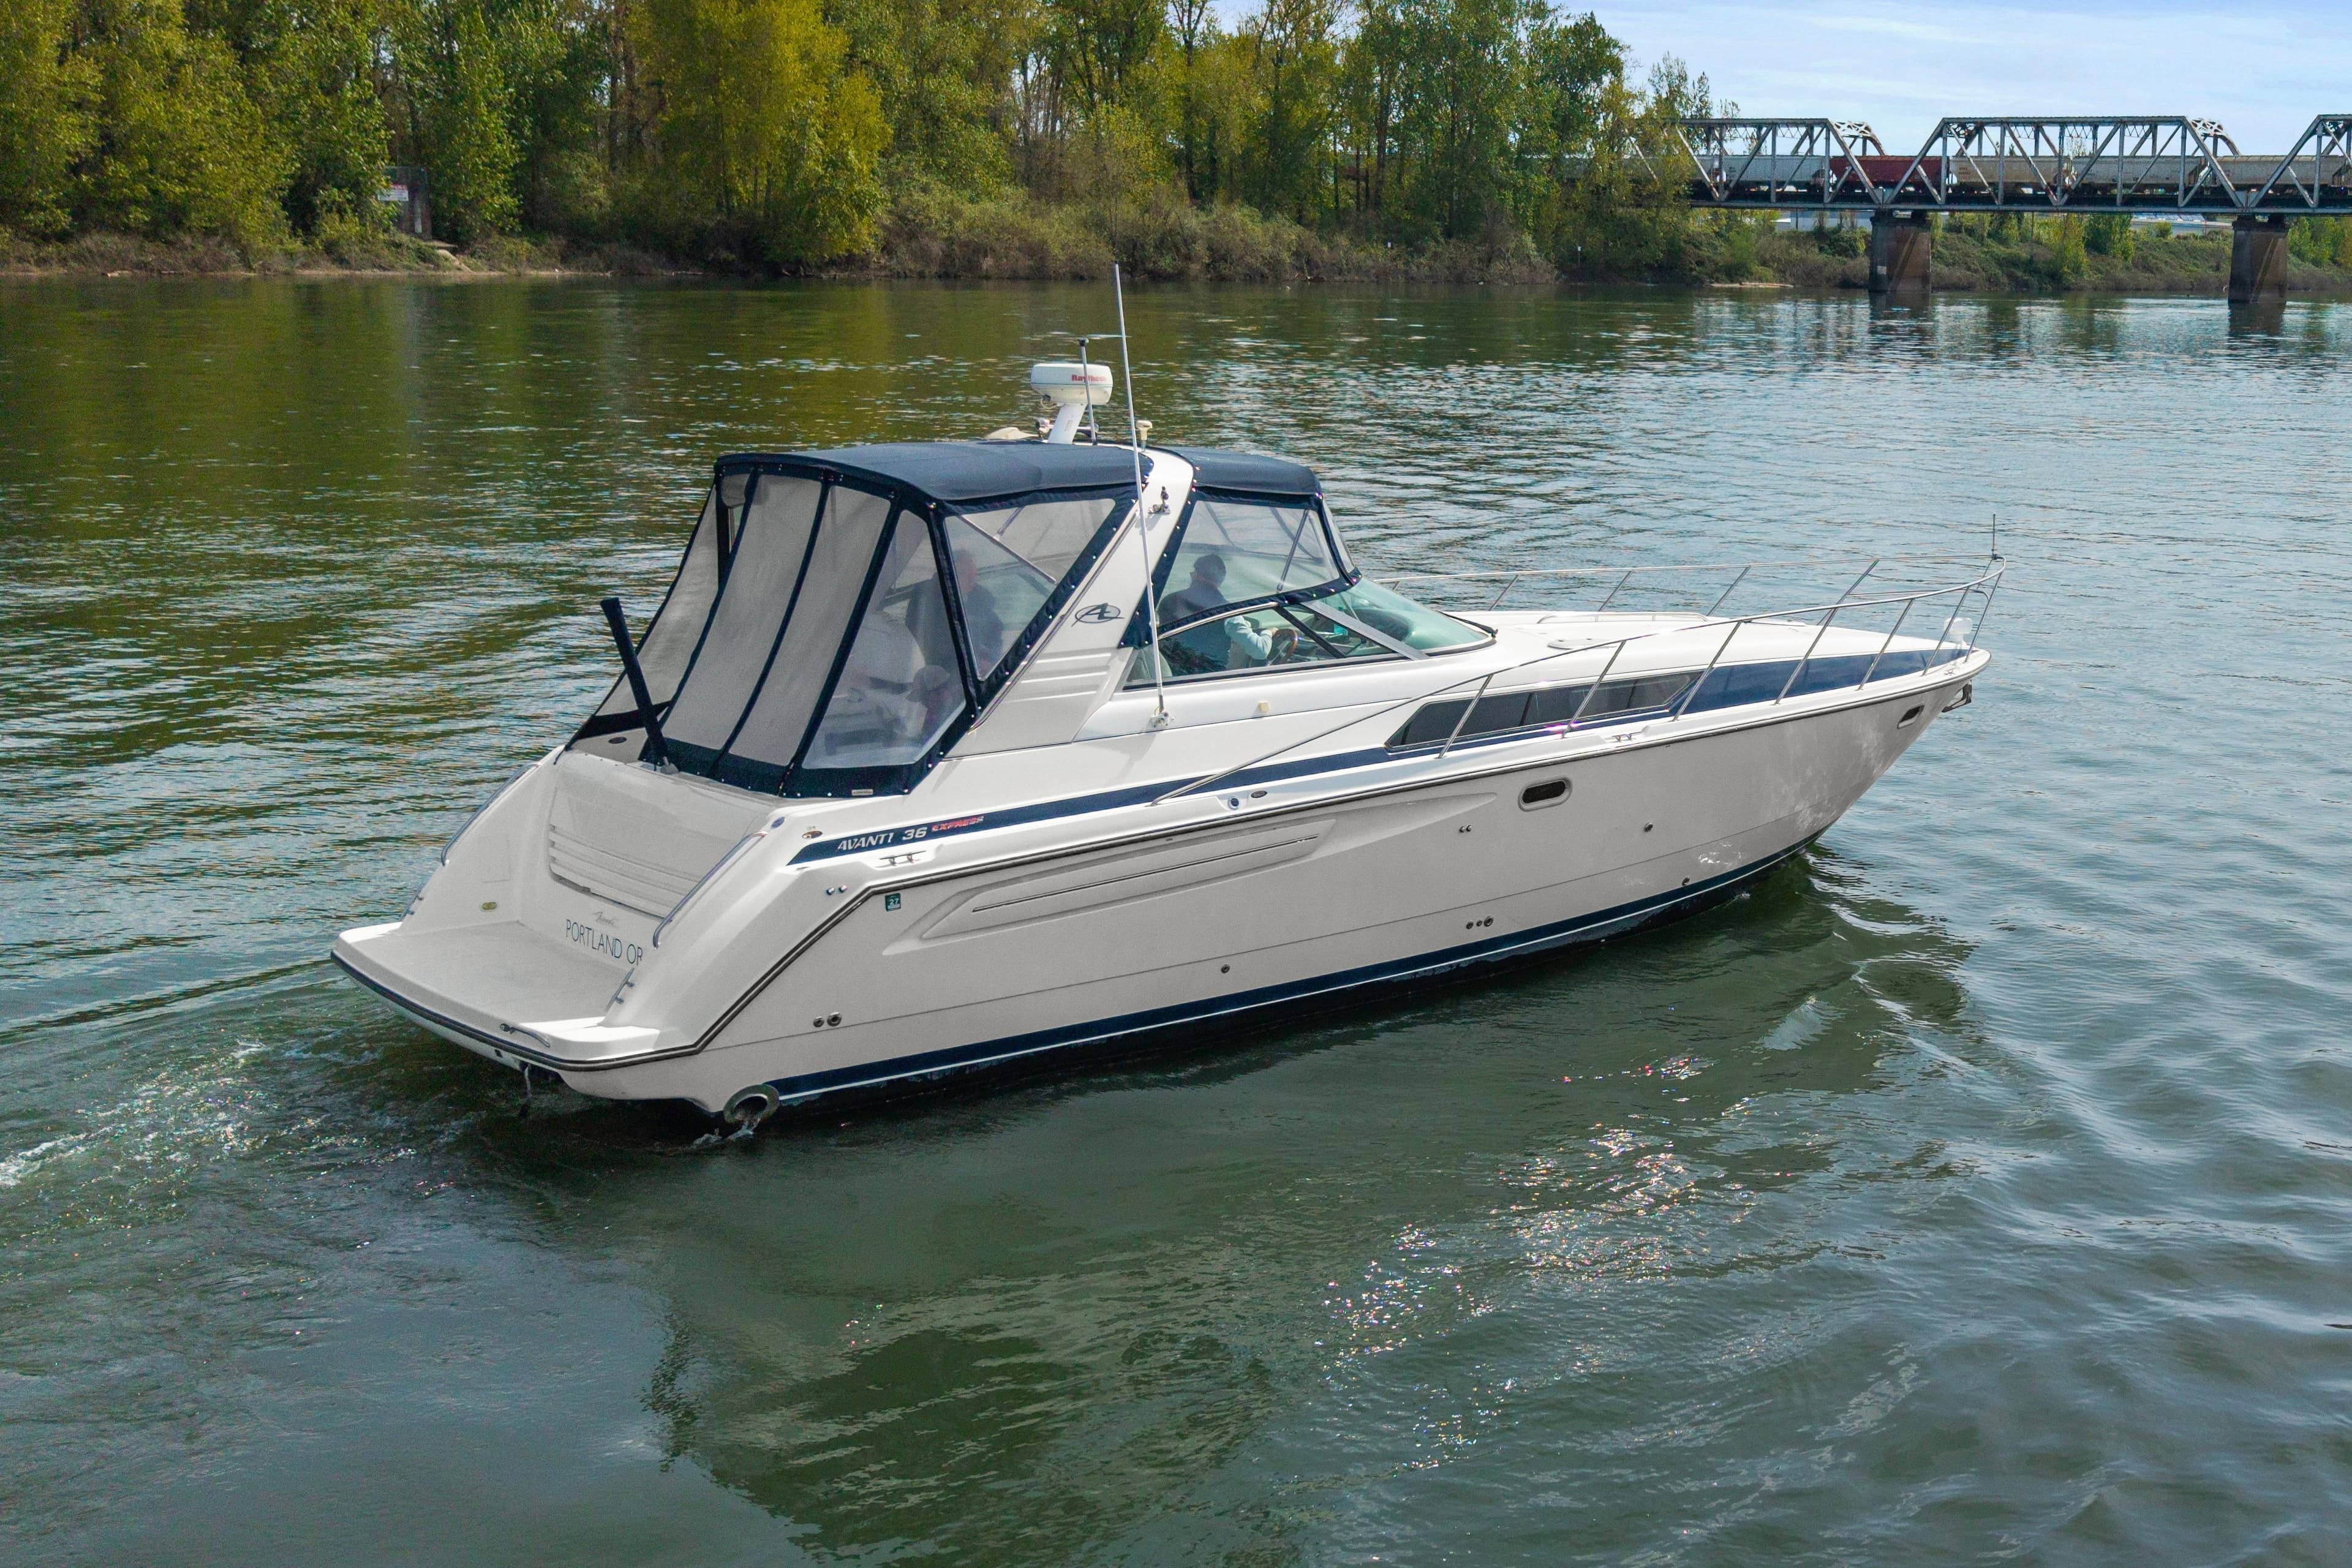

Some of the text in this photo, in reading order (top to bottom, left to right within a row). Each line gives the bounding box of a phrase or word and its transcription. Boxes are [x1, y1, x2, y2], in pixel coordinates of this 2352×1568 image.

[837, 832, 894, 851] AVANTI
[902, 827, 927, 841] 36
[565, 919, 623, 959] PORTLAND
[627, 943, 643, 967] OR
